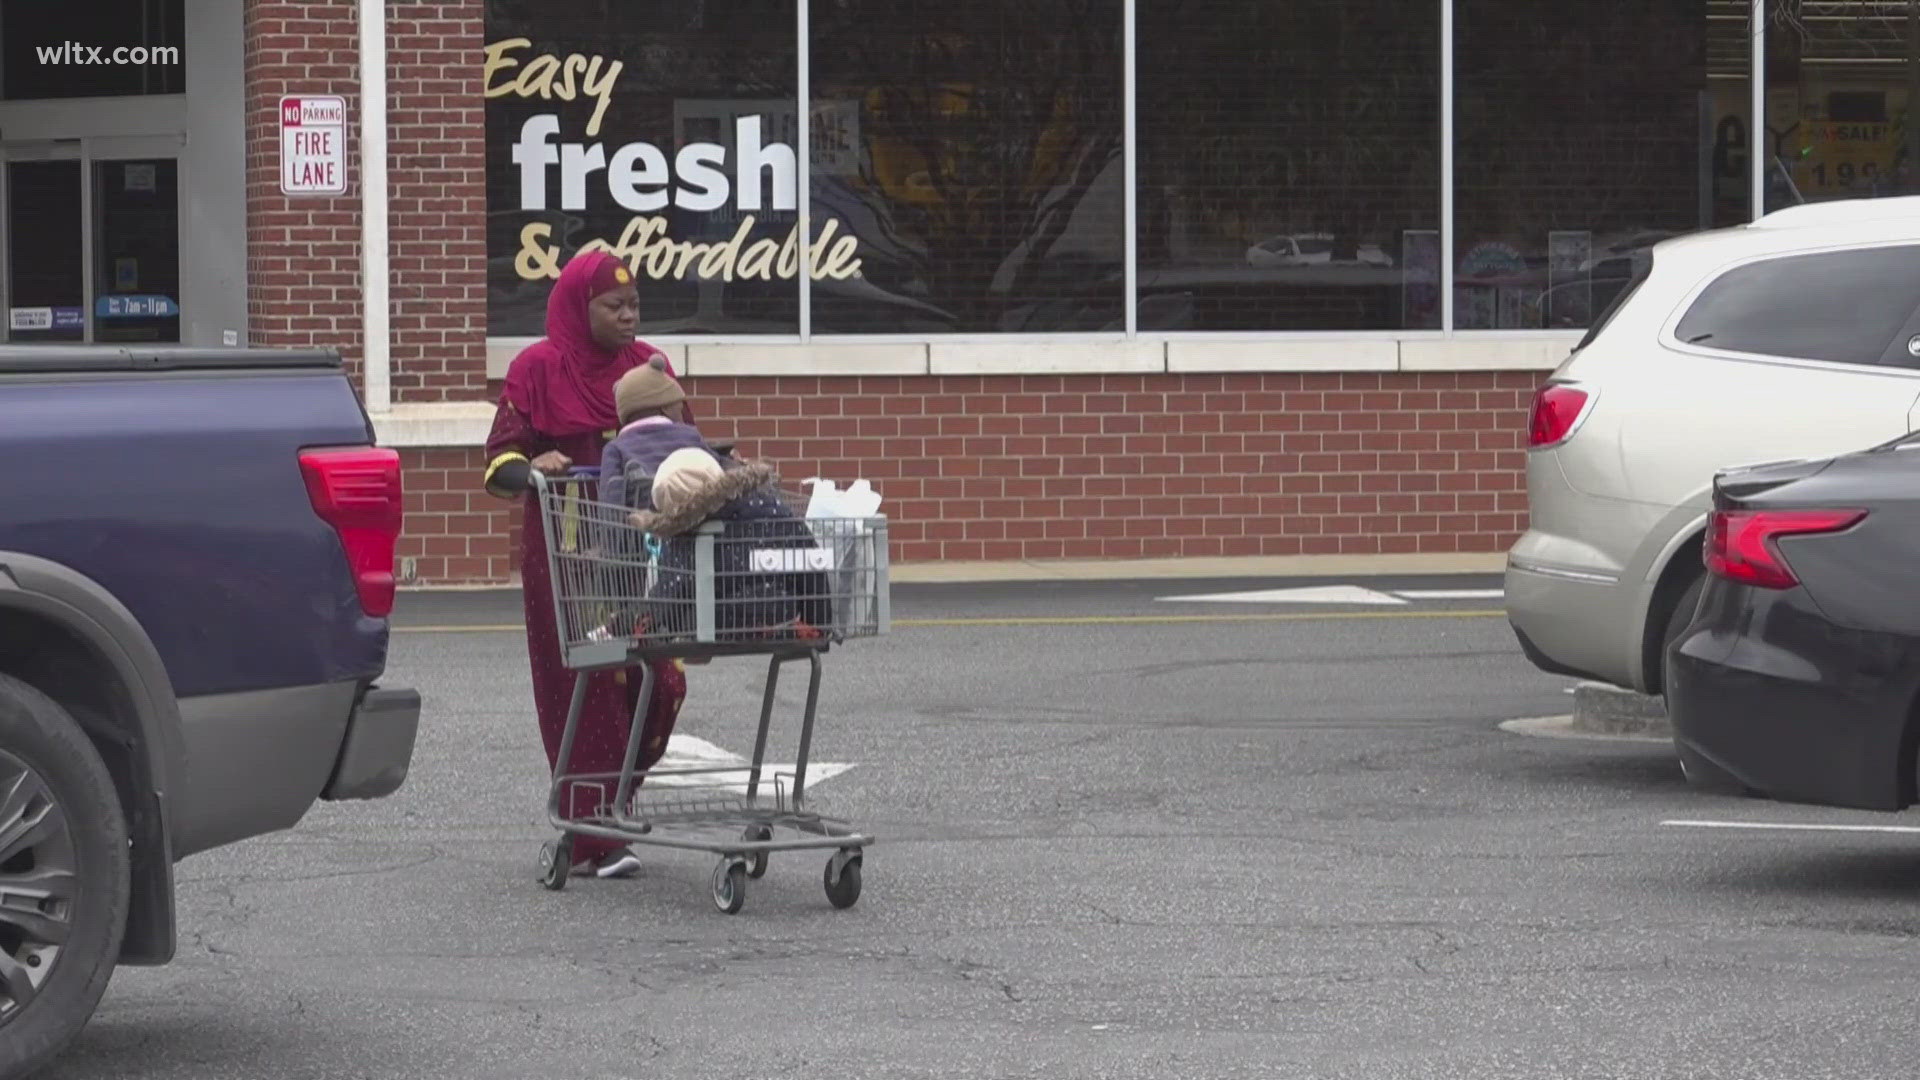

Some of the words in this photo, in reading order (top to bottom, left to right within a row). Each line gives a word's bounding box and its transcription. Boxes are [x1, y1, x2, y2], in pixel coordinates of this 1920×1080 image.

[484, 37, 624, 137] Easy
[284, 106, 299, 122] NO
[303, 107, 341, 121] PARKING
[295, 131, 332, 156] FIRE
[512, 114, 797, 211] fresh
[292, 161, 335, 186] LANE
[514, 222, 562, 280] &
